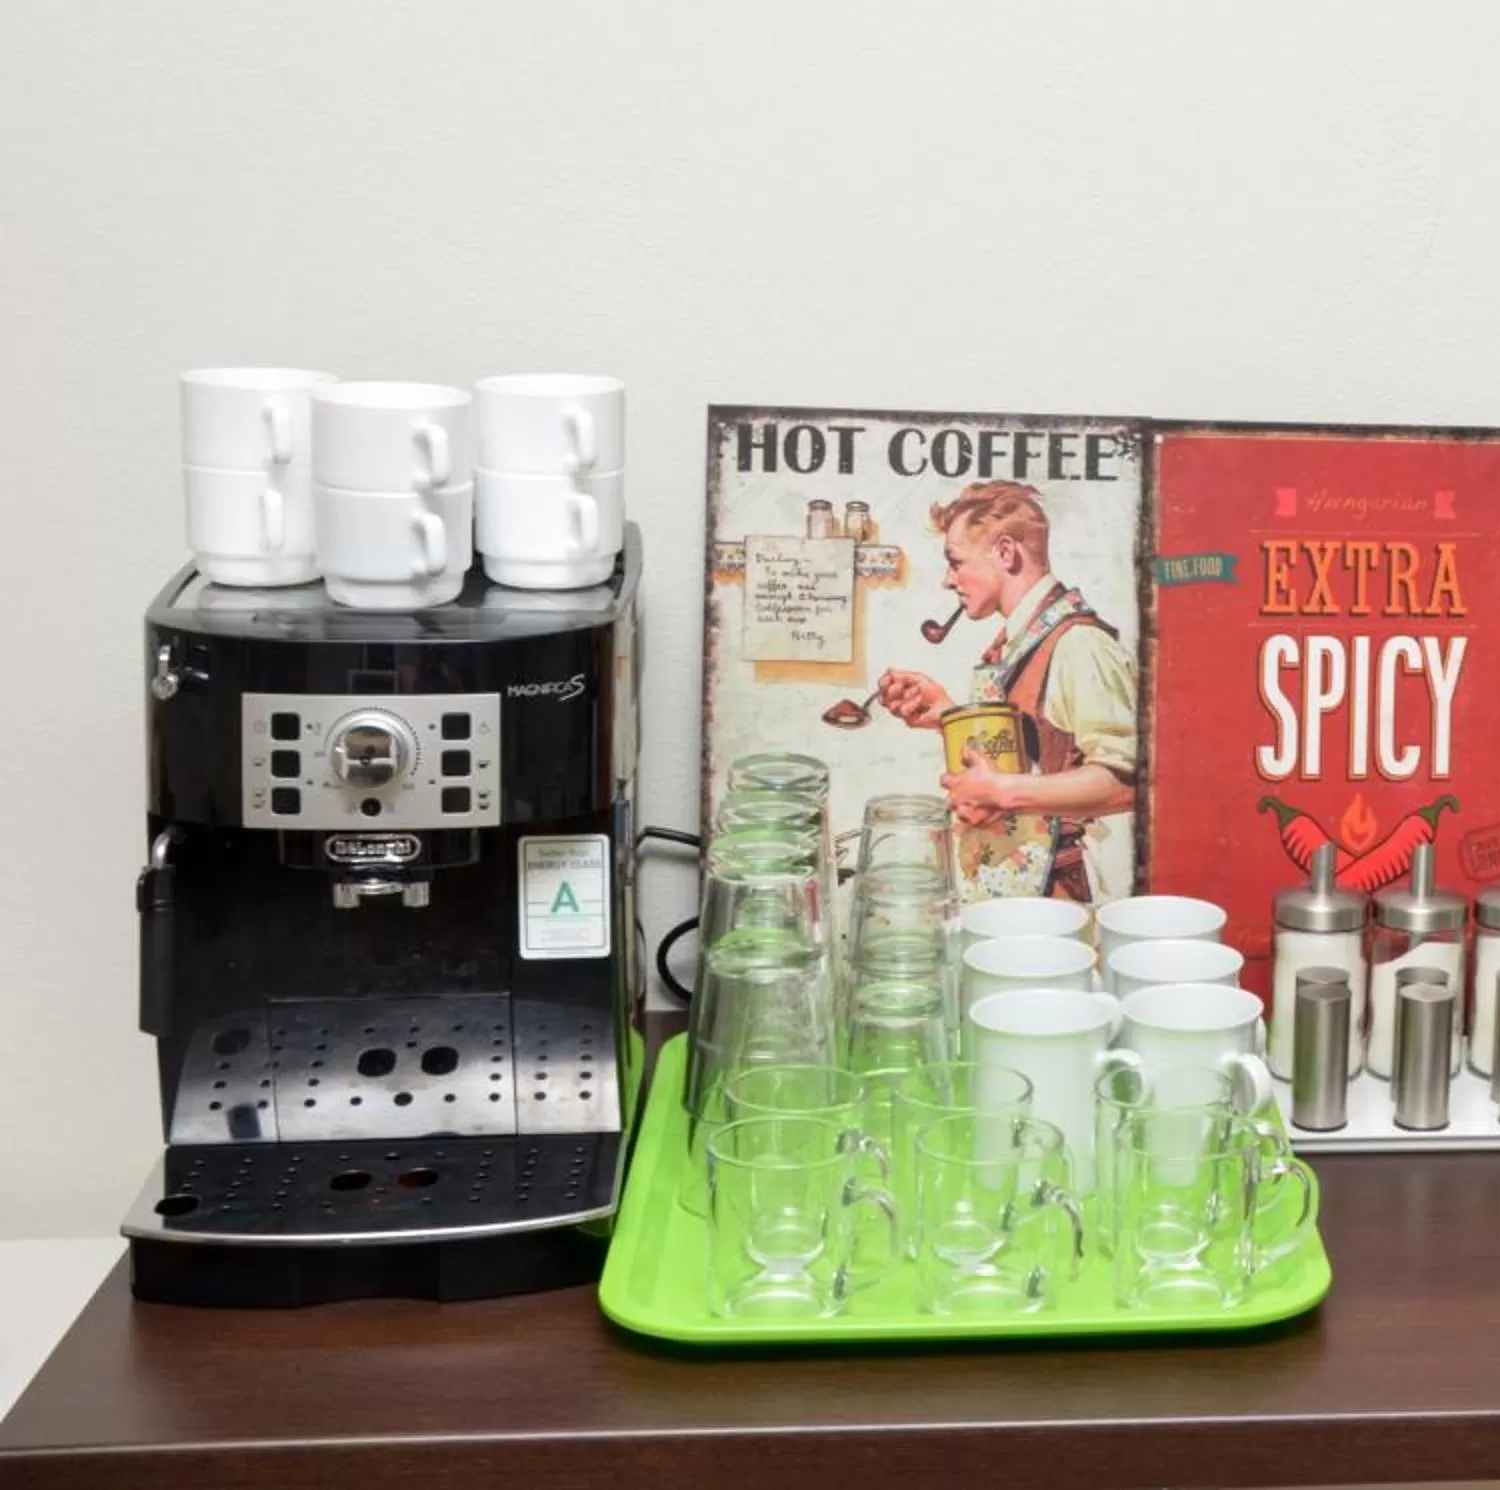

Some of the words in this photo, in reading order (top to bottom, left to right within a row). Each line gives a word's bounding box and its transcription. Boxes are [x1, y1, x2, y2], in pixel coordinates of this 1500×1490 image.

[736, 423, 867, 475] HOT
[887, 427, 1119, 482] COFFEE
[1304, 487, 1428, 522] Hungarian
[1191, 556, 1224, 578] FOOD
[1258, 540, 1469, 618] EXTRA
[560, 673, 585, 701] S
[1256, 634, 1469, 782] SPICY
[550, 880, 580, 913] A
